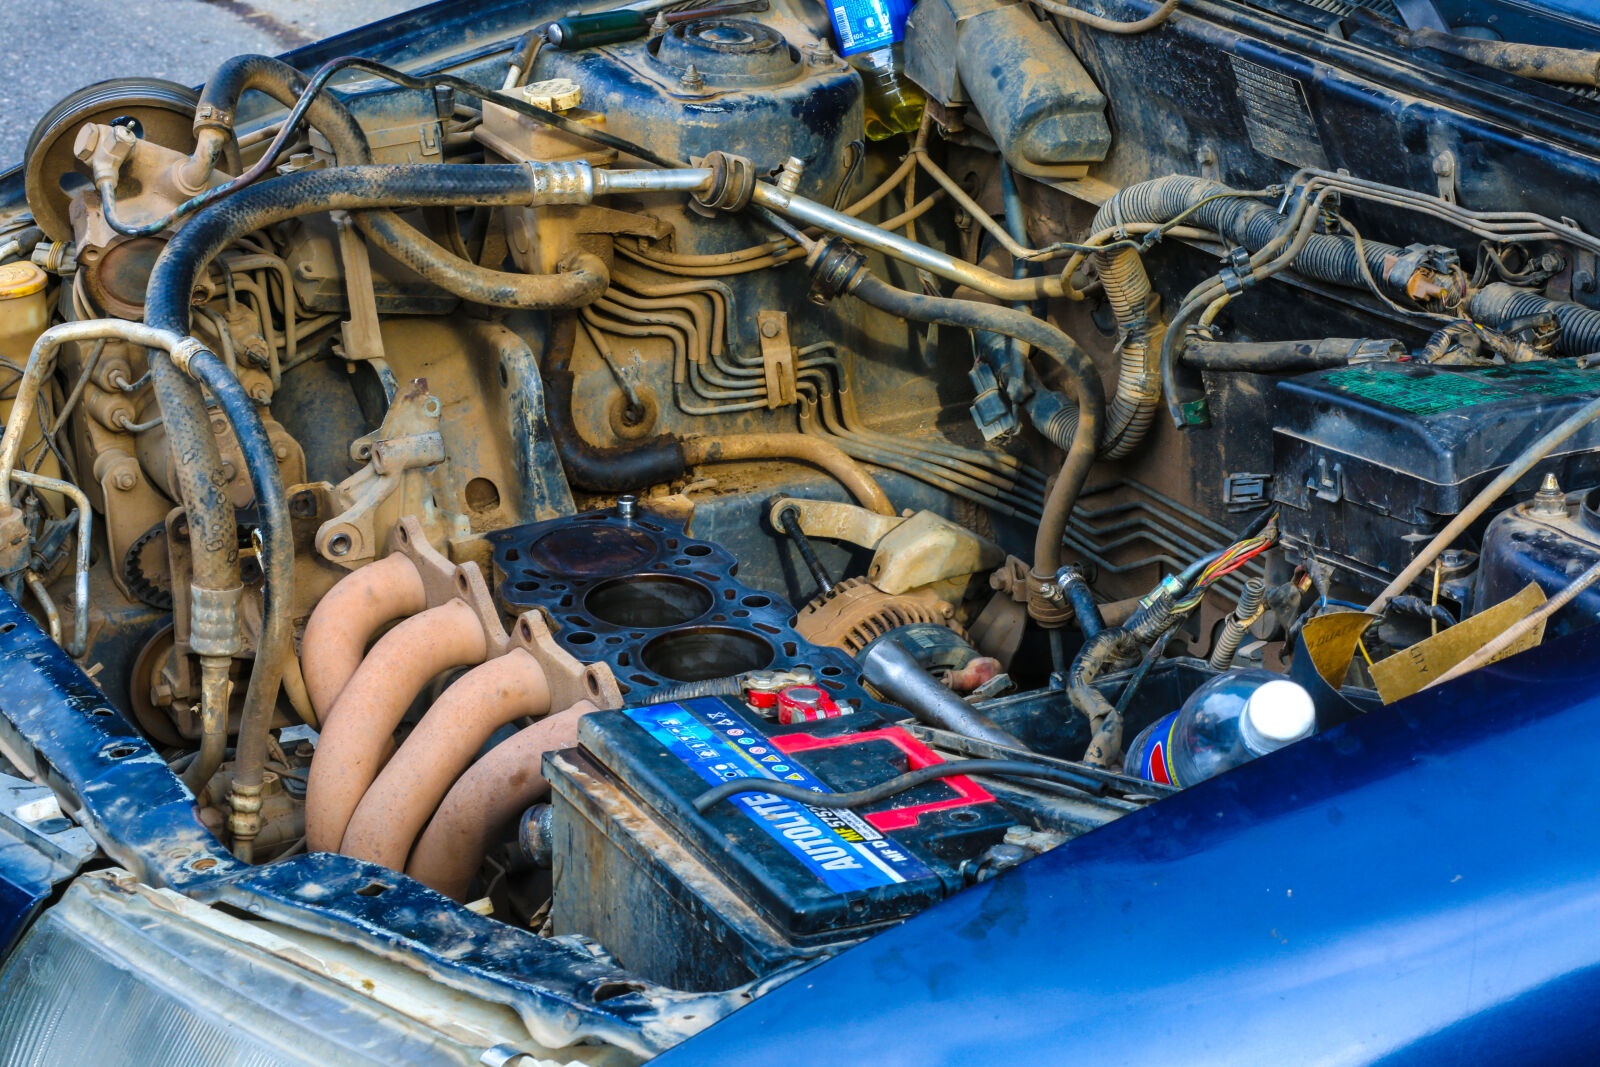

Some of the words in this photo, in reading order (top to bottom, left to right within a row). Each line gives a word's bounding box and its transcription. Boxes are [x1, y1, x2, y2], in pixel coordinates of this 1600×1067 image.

[741, 792, 863, 871] AUTOLITE
[833, 827, 864, 843] MF
[880, 848, 908, 863] MF
